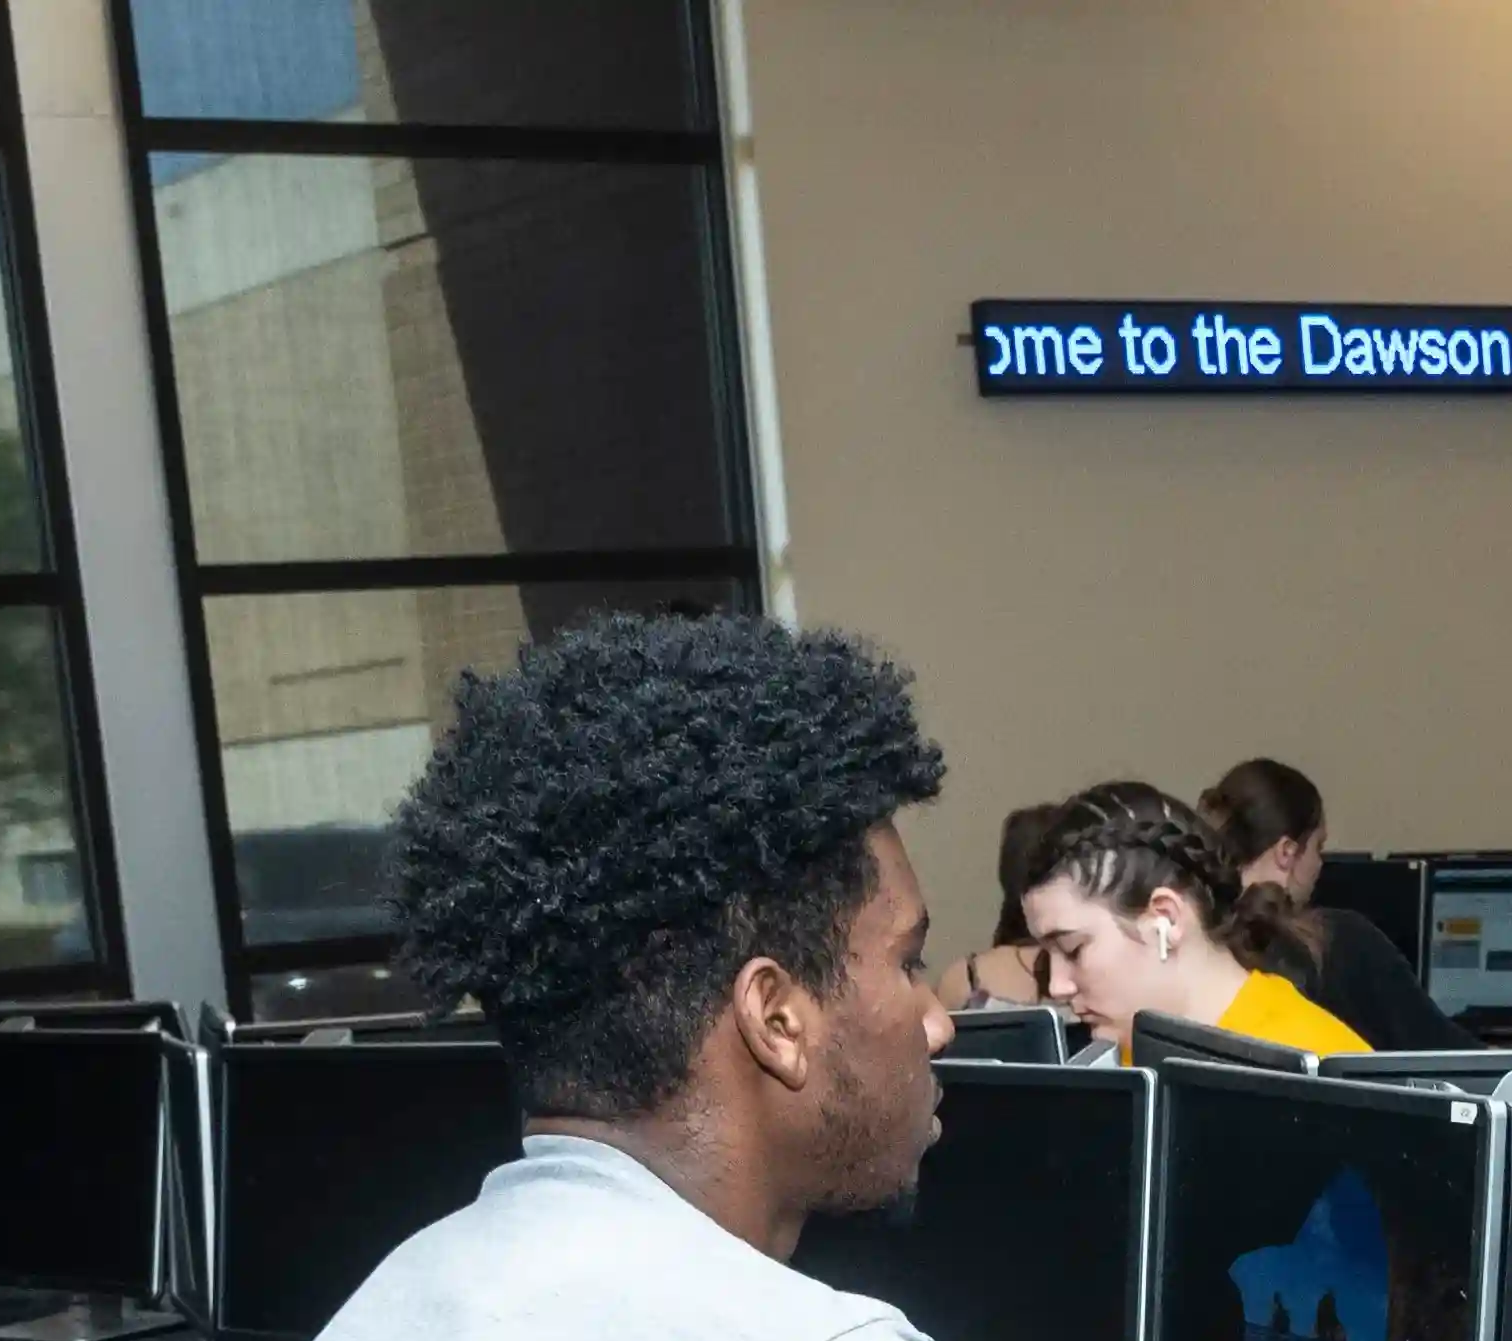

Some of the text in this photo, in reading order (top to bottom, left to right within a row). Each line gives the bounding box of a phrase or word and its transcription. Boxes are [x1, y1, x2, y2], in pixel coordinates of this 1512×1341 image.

[1119, 314, 1177, 375] to
[1192, 314, 1282, 375] the
[1300, 314, 1512, 376] Dawson
